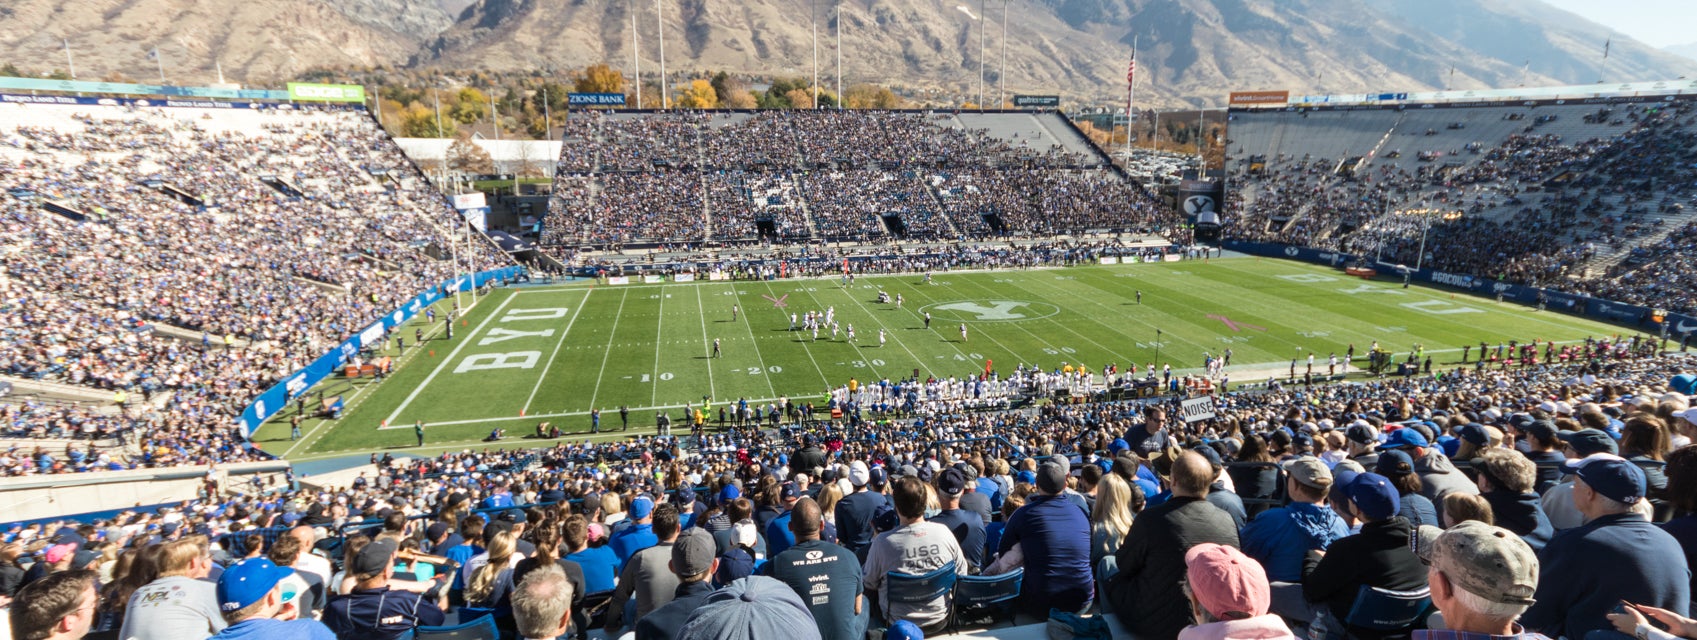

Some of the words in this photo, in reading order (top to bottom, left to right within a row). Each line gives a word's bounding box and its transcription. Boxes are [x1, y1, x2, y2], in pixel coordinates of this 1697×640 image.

[569, 95, 597, 103] ZIONS
[598, 95, 625, 104] BANK
[453, 307, 568, 374] BYU
[1184, 401, 1214, 417] NOISE
[906, 544, 941, 559] usa
